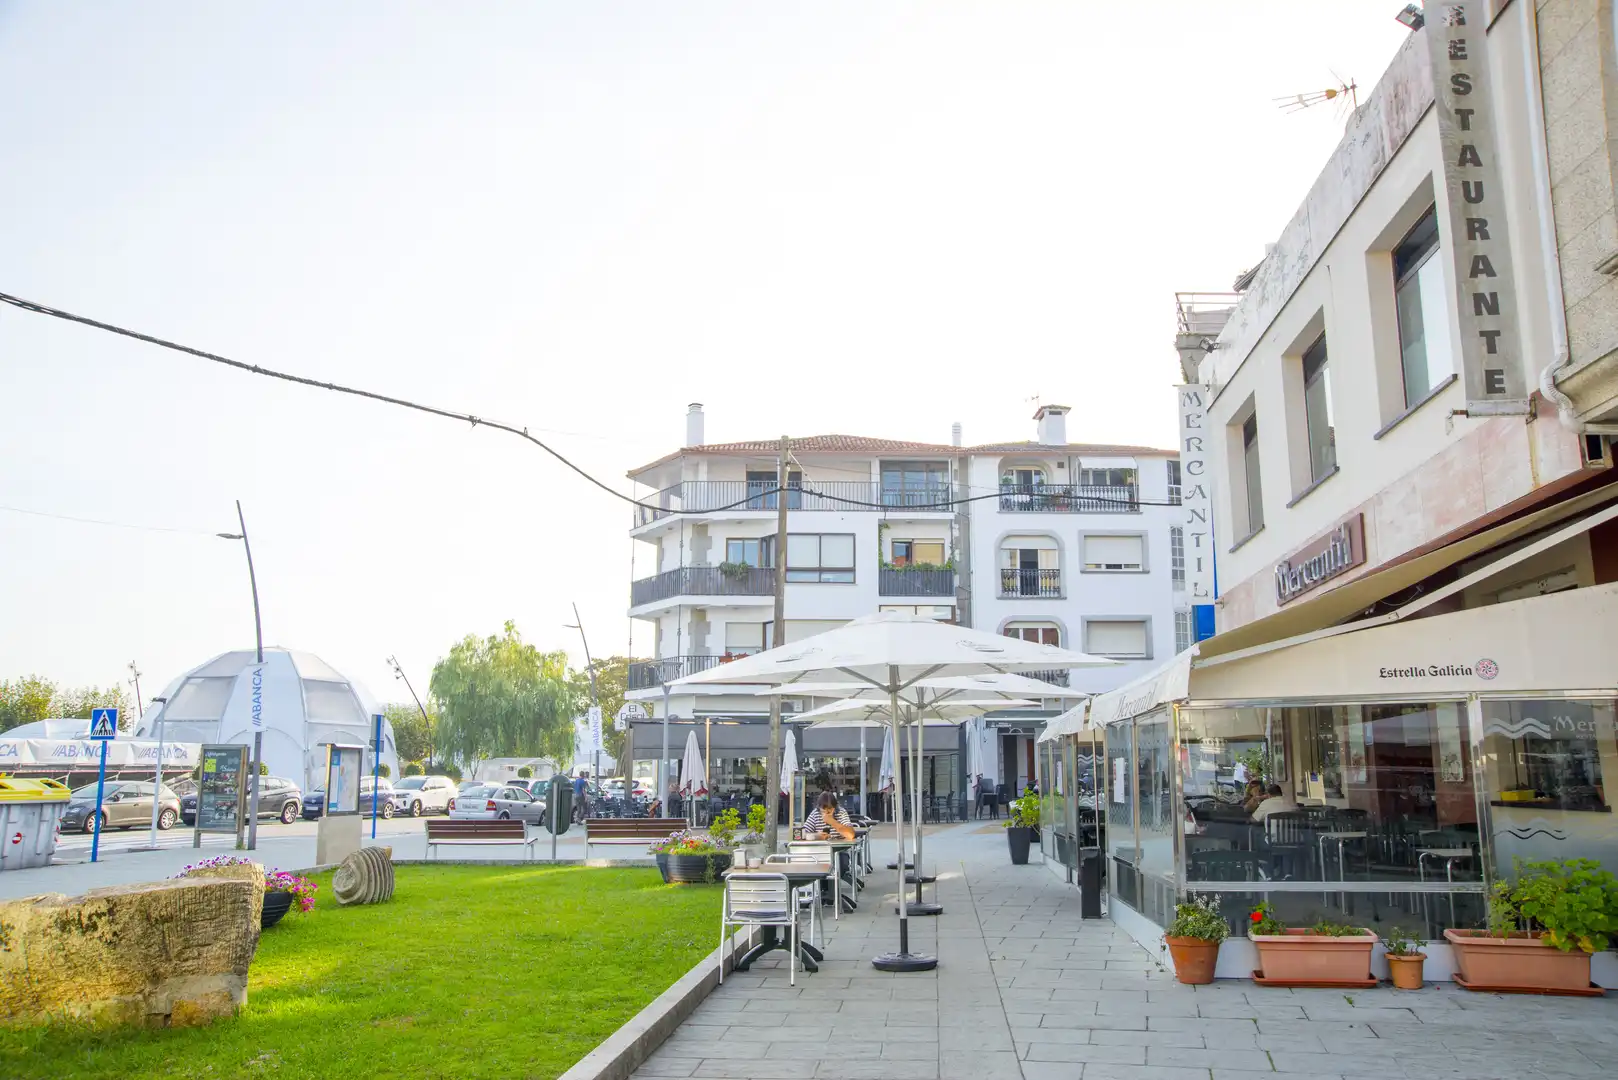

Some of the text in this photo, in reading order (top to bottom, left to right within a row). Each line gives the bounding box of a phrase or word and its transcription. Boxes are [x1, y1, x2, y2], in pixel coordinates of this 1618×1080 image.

[1183, 391, 1208, 598] MERCANTIL
[1379, 664, 1473, 679] Estrella Galicia
